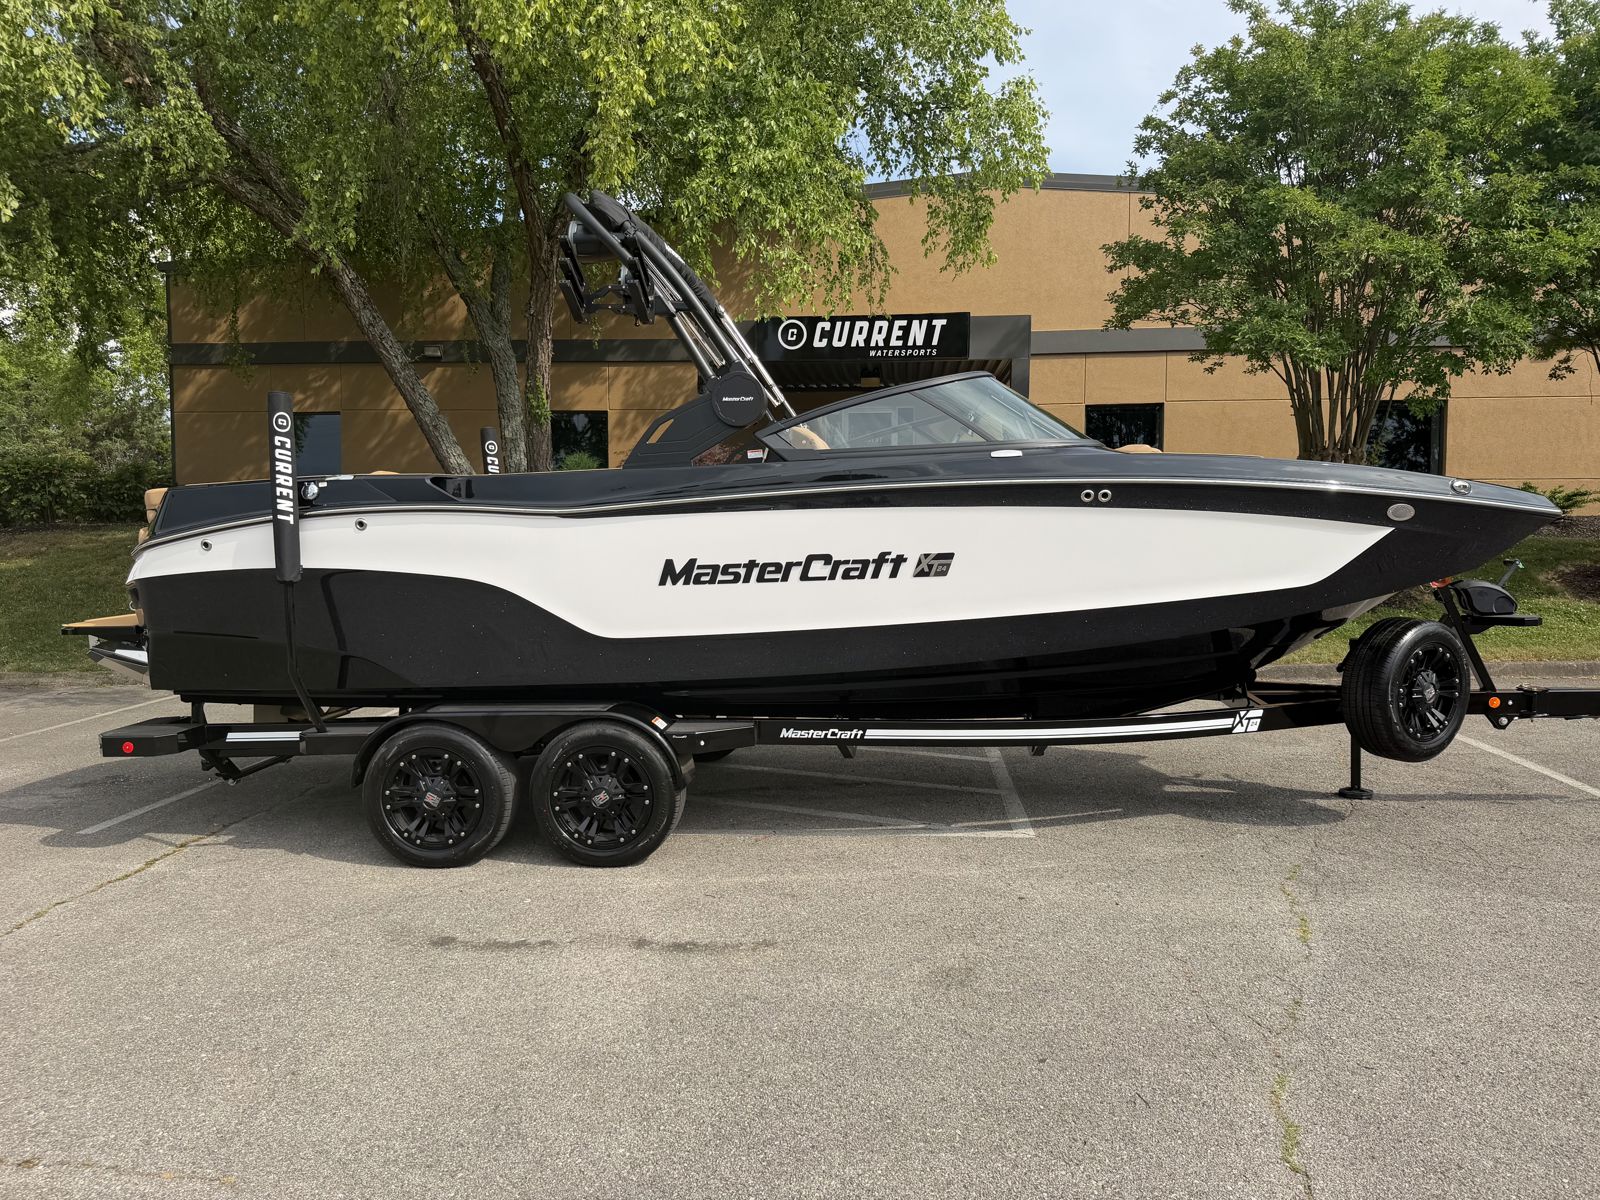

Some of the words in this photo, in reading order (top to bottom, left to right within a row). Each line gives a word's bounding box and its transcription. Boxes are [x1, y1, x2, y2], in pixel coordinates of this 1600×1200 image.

[812, 318, 948, 348] CURRENT
[869, 348, 937, 357] WATERSPORTS
[274, 435, 295, 525] CURRENT
[658, 551, 908, 586] MasterCraft
[780, 727, 864, 739] MasterCraft
